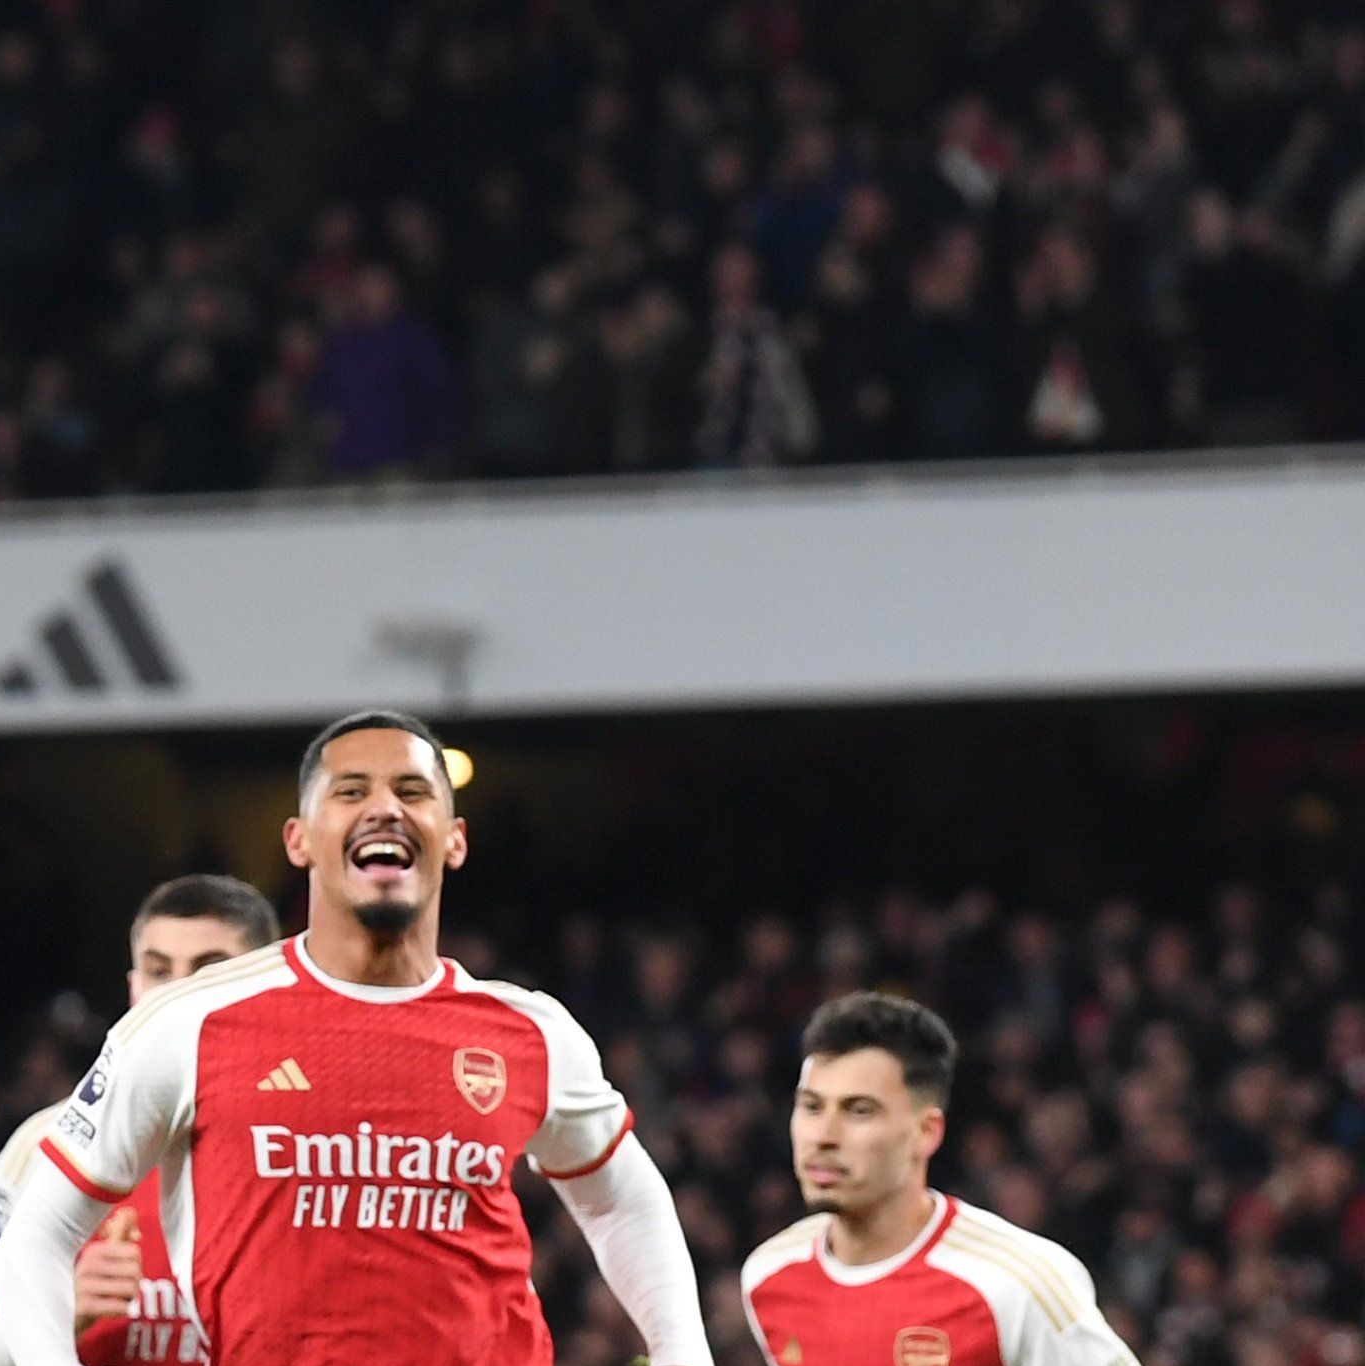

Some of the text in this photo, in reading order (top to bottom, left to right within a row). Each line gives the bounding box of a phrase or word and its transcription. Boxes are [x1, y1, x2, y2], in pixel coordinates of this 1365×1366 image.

[250, 1121, 505, 1187] Emirates
[292, 1184, 469, 1231] FLY BETTER
